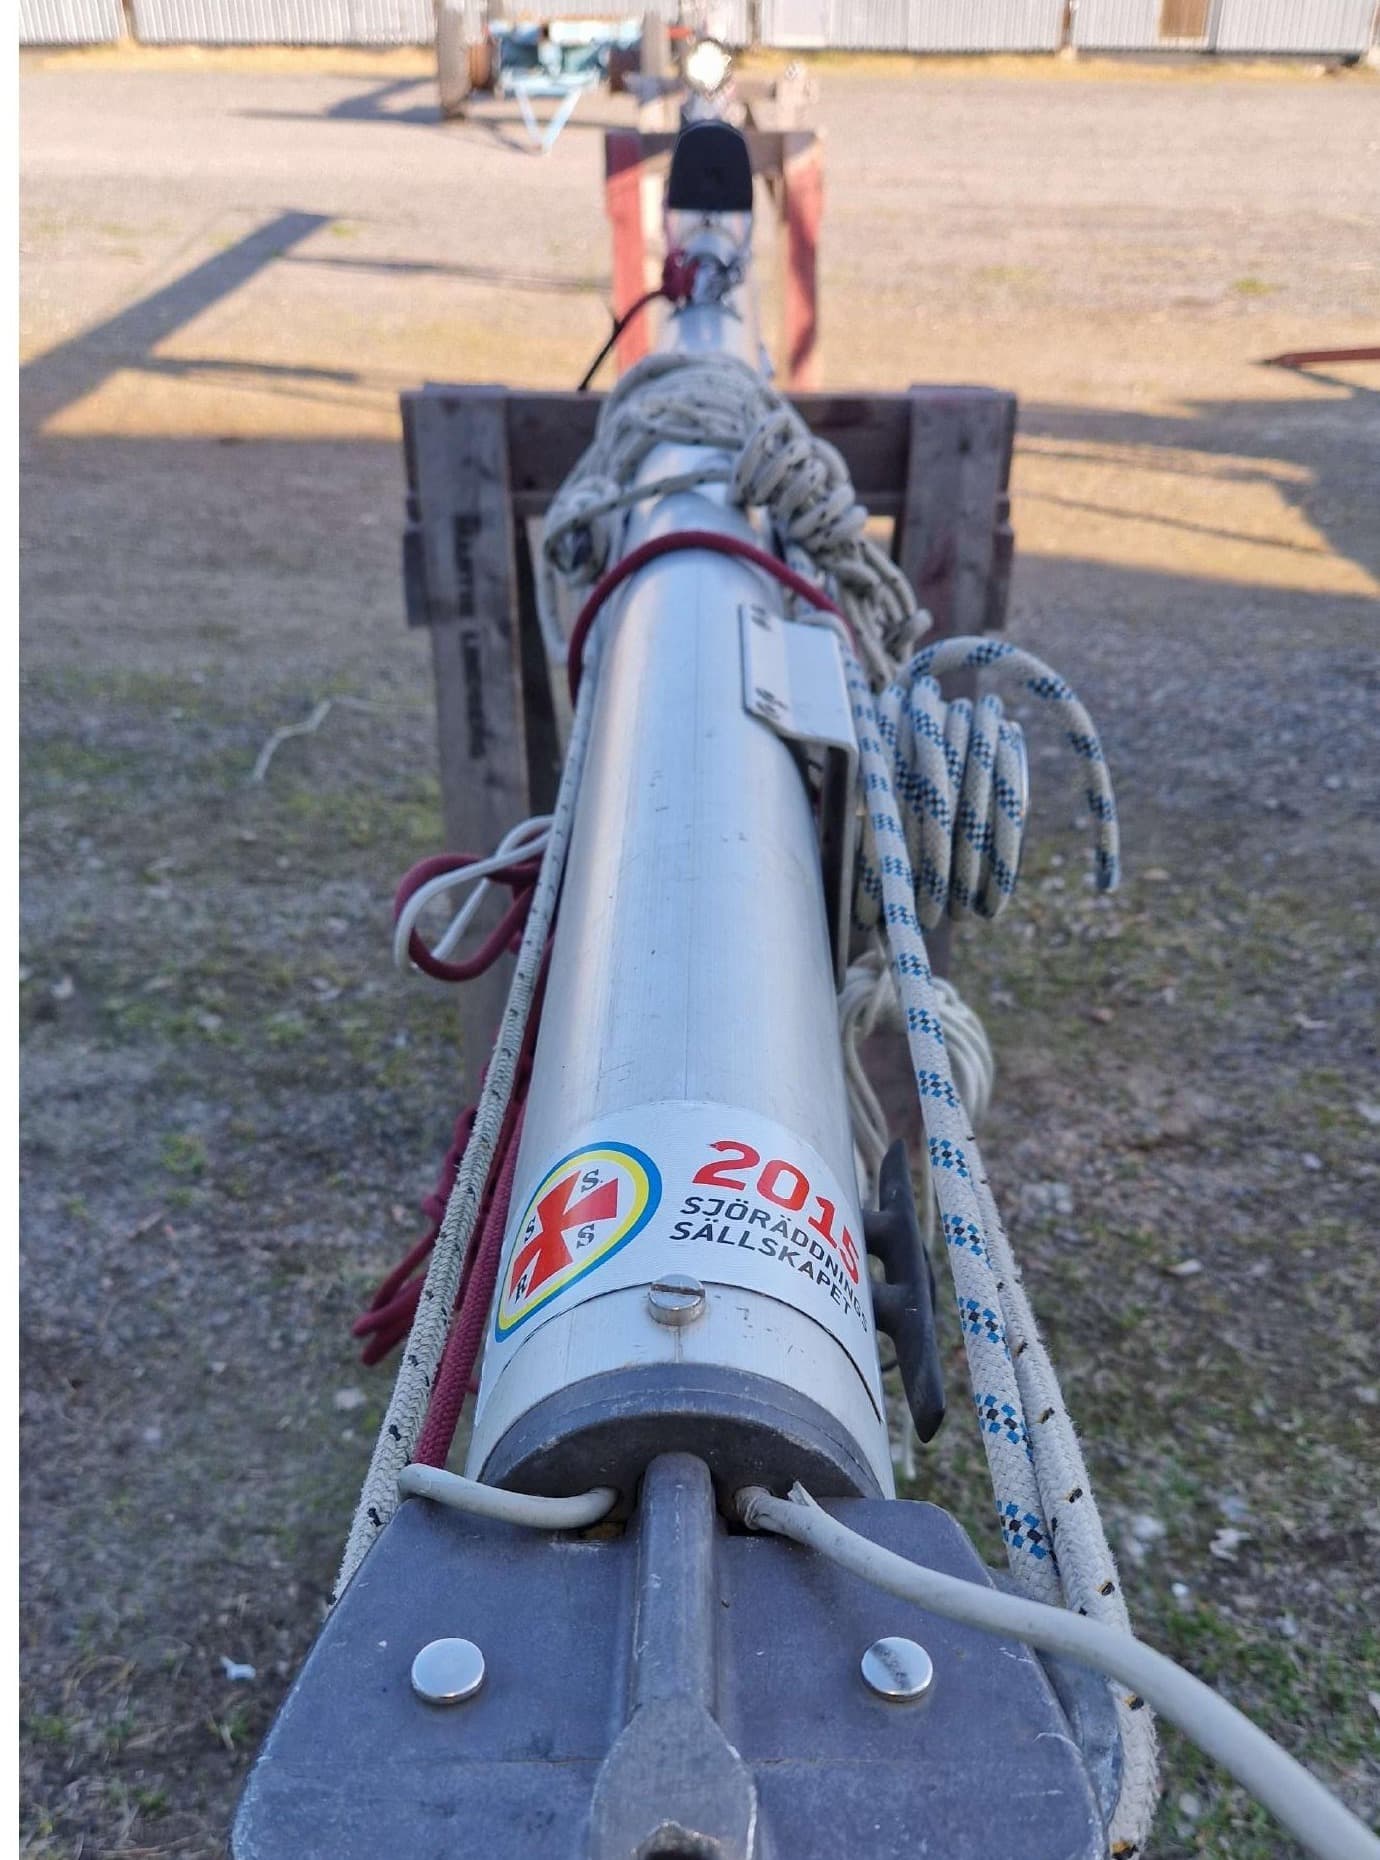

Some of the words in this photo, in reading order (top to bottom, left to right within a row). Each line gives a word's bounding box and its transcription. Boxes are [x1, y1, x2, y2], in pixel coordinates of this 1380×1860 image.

[669, 1217, 852, 1315] SÄLLSKAPET
[680, 1196, 868, 1333] SJÖRÄDDNINGS
[692, 1140, 860, 1285] 2015
